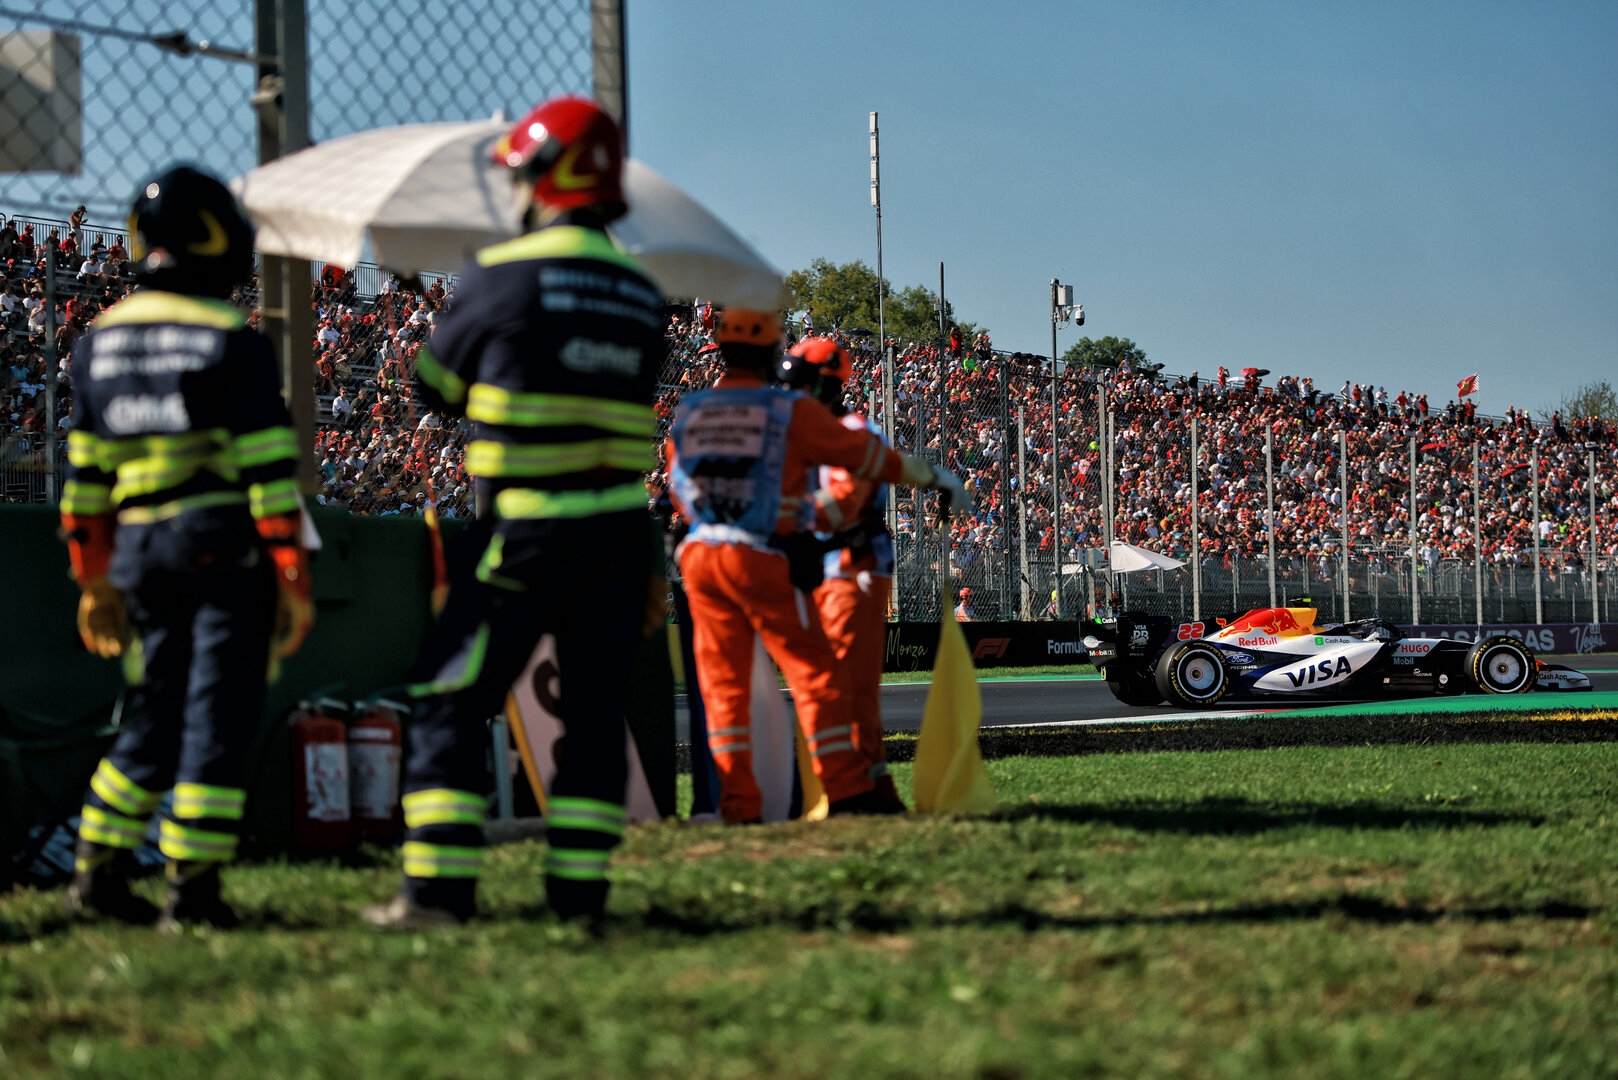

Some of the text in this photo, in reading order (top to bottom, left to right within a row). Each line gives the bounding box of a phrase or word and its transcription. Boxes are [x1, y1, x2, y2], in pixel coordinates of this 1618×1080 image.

[1178, 623, 1205, 640] 22
[1569, 624, 1606, 655] Vegas
[886, 627, 928, 671] Monza
[1238, 636, 1277, 647] Red Bull
[1401, 644, 1430, 653] HUGO
[1474, 629, 1556, 652] GAS
[1231, 655, 1249, 663] Ford
[1393, 657, 1415, 665] Mobil
[1282, 656, 1352, 688] VISA
